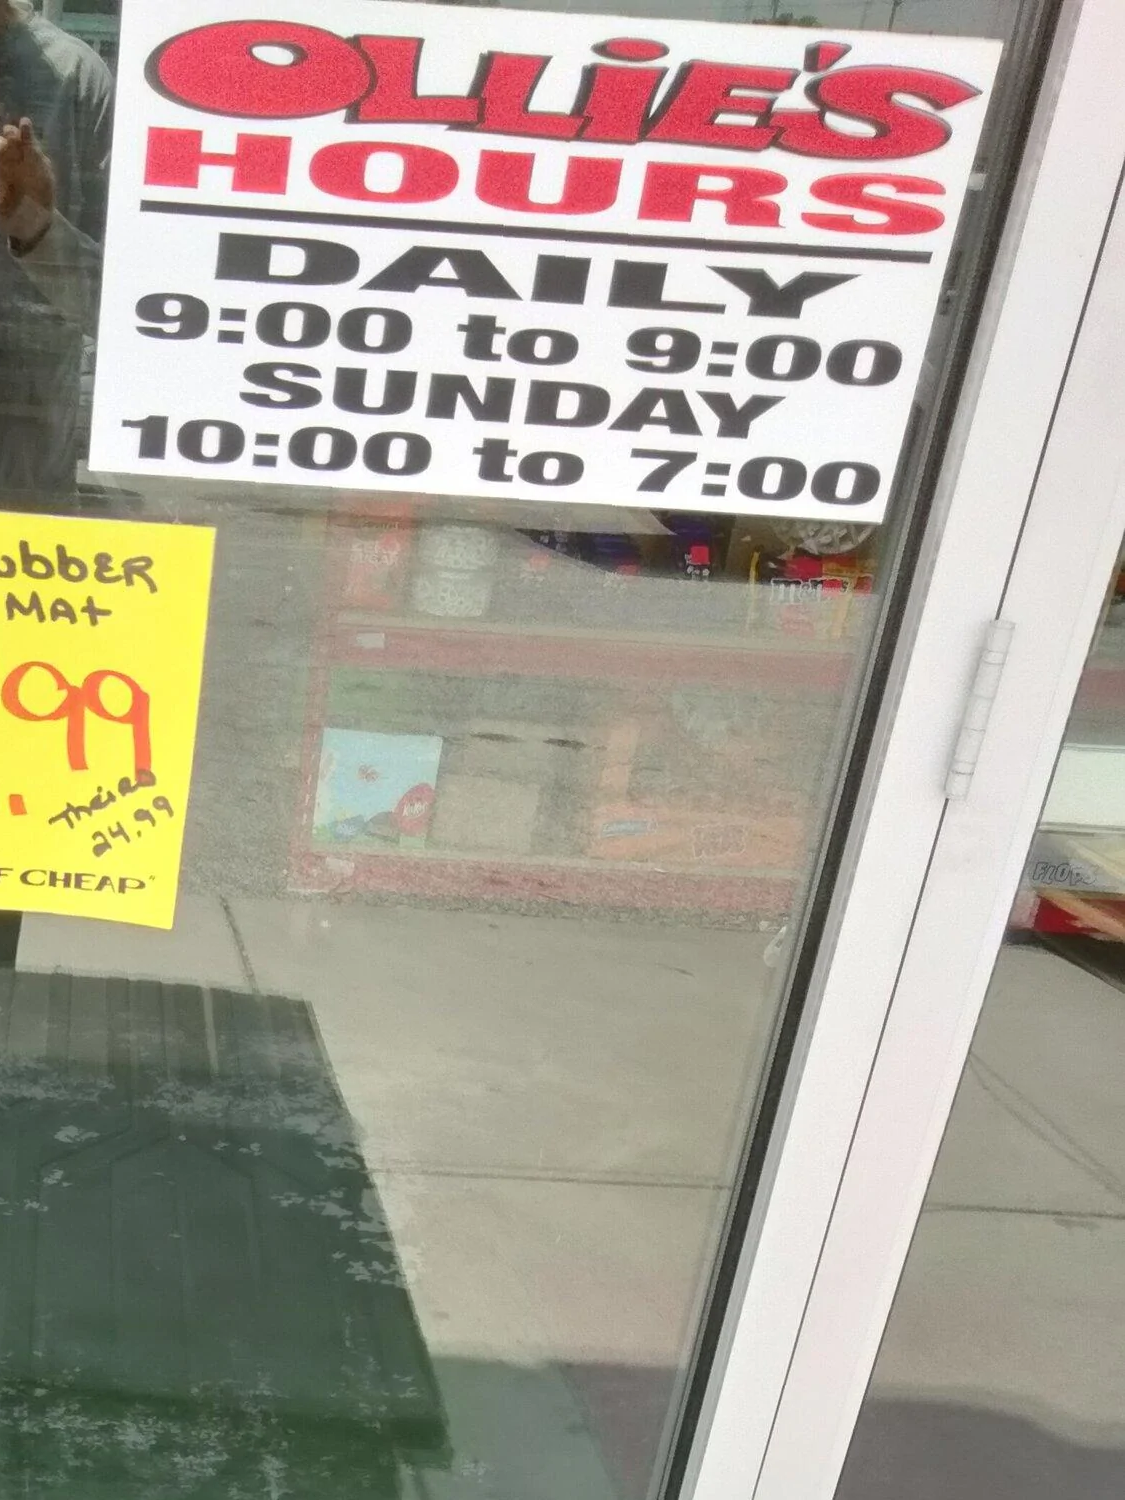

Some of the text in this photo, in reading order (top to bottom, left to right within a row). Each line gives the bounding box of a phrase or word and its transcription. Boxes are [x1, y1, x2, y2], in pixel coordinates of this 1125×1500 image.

[142, 126, 946, 235] HOURS
[214, 232, 861, 320] DAILY
[134, 292, 904, 388] 9:00 to 9:00
[240, 361, 787, 441] SUNDAY
[121, 416, 882, 507] 10:00 to 7:00
[90, 796, 175, 858] 24.99
